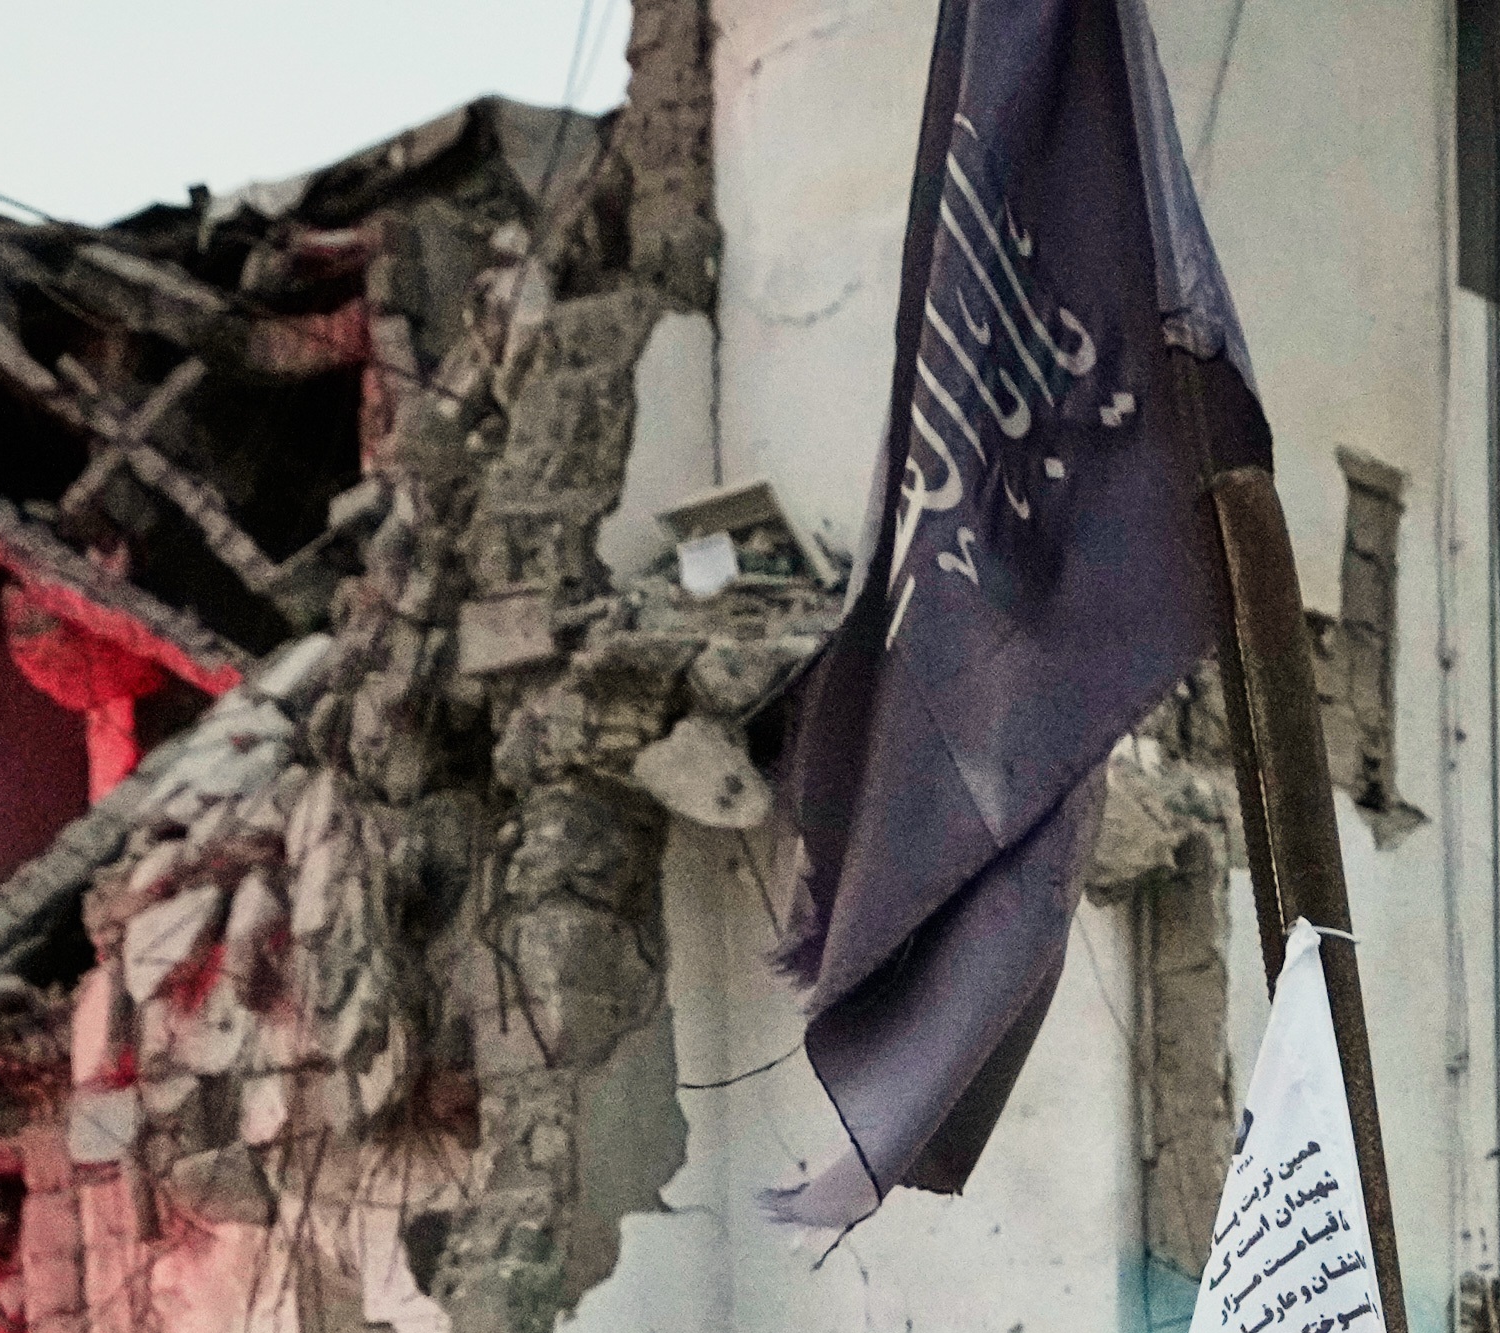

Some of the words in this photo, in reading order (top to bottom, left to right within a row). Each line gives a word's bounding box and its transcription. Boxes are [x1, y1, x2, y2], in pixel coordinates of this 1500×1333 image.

[1279, 1141, 1321, 1180] همین
[1241, 1168, 1275, 1213] تربت
[1276, 1170, 1339, 1229] شهیدان
[1214, 1211, 1241, 1247] پا
[1237, 1213, 1271, 1258] است
[1263, 1210, 1339, 1278] قیامت
[1209, 1251, 1232, 1291] که
[1311, 1249, 1368, 1295] اشقان
[1221, 1273, 1262, 1326] مزار
[1300, 1284, 1313, 1305] و
